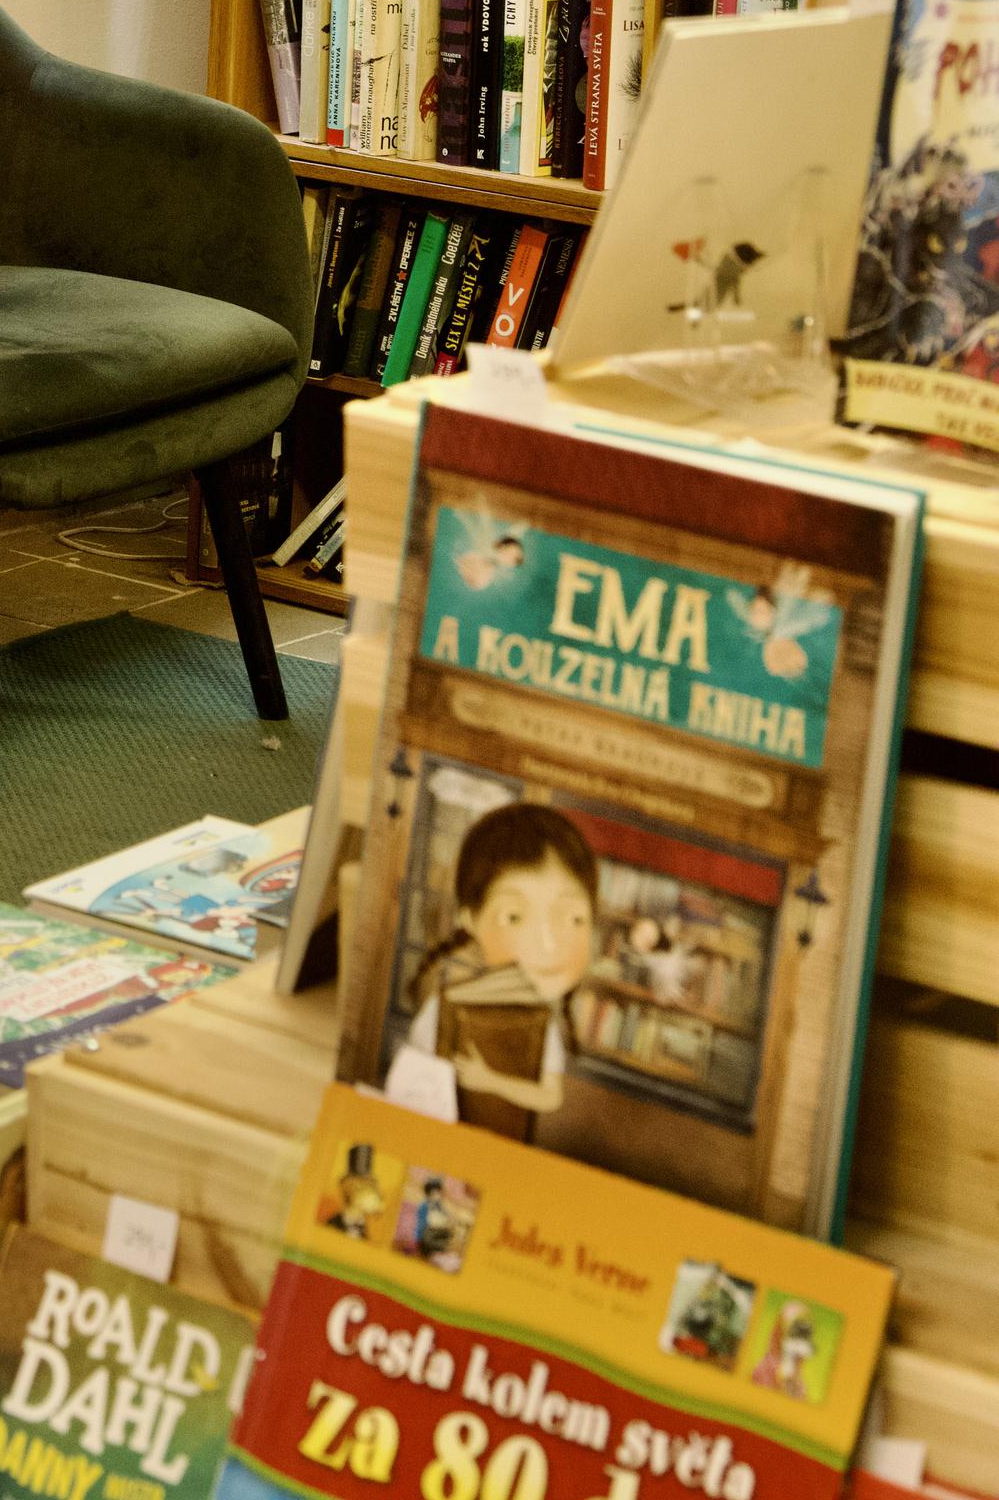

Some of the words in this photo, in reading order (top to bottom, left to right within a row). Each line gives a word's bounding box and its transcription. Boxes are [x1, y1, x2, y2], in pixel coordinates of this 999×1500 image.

[302, 11, 315, 58] clarke
[370, 26, 376, 35] na
[623, 19, 645, 32] LISA
[592, 32, 604, 73] SVĚTA
[479, 86, 488, 113] Irving
[590, 74, 601, 123] STRANA
[478, 114, 486, 139] John
[588, 126, 598, 156] LEVÁ
[442, 223, 464, 265] Coetzee
[555, 238, 575, 277] NEMESIS
[388, 281, 405, 323] ZVLÁŠTNÍ
[399, 230, 415, 269] OPERACE
[457, 272, 478, 311] MĚSTĚ
[416, 335, 432, 359] Deník
[425, 295, 443, 335] špatného
[439, 276, 448, 296] roku
[452, 313, 466, 330] VE
[445, 329, 461, 351] SEX
[550, 552, 712, 674] EMA
[432, 614, 461, 666] A
[475, 625, 671, 723] KOUZELNÁ
[687, 680, 808, 759] KNIHA
[488, 1214, 564, 1269] Jules
[574, 1241, 653, 1297] Verne
[26, 1268, 222, 1398] ROALD
[1, 1336, 189, 1486] DAHL
[326, 1294, 456, 1392] Cesta
[461, 1344, 612, 1452] kolem
[615, 1419, 757, 1500] světa
[420, 1411, 549, 1500] 80
